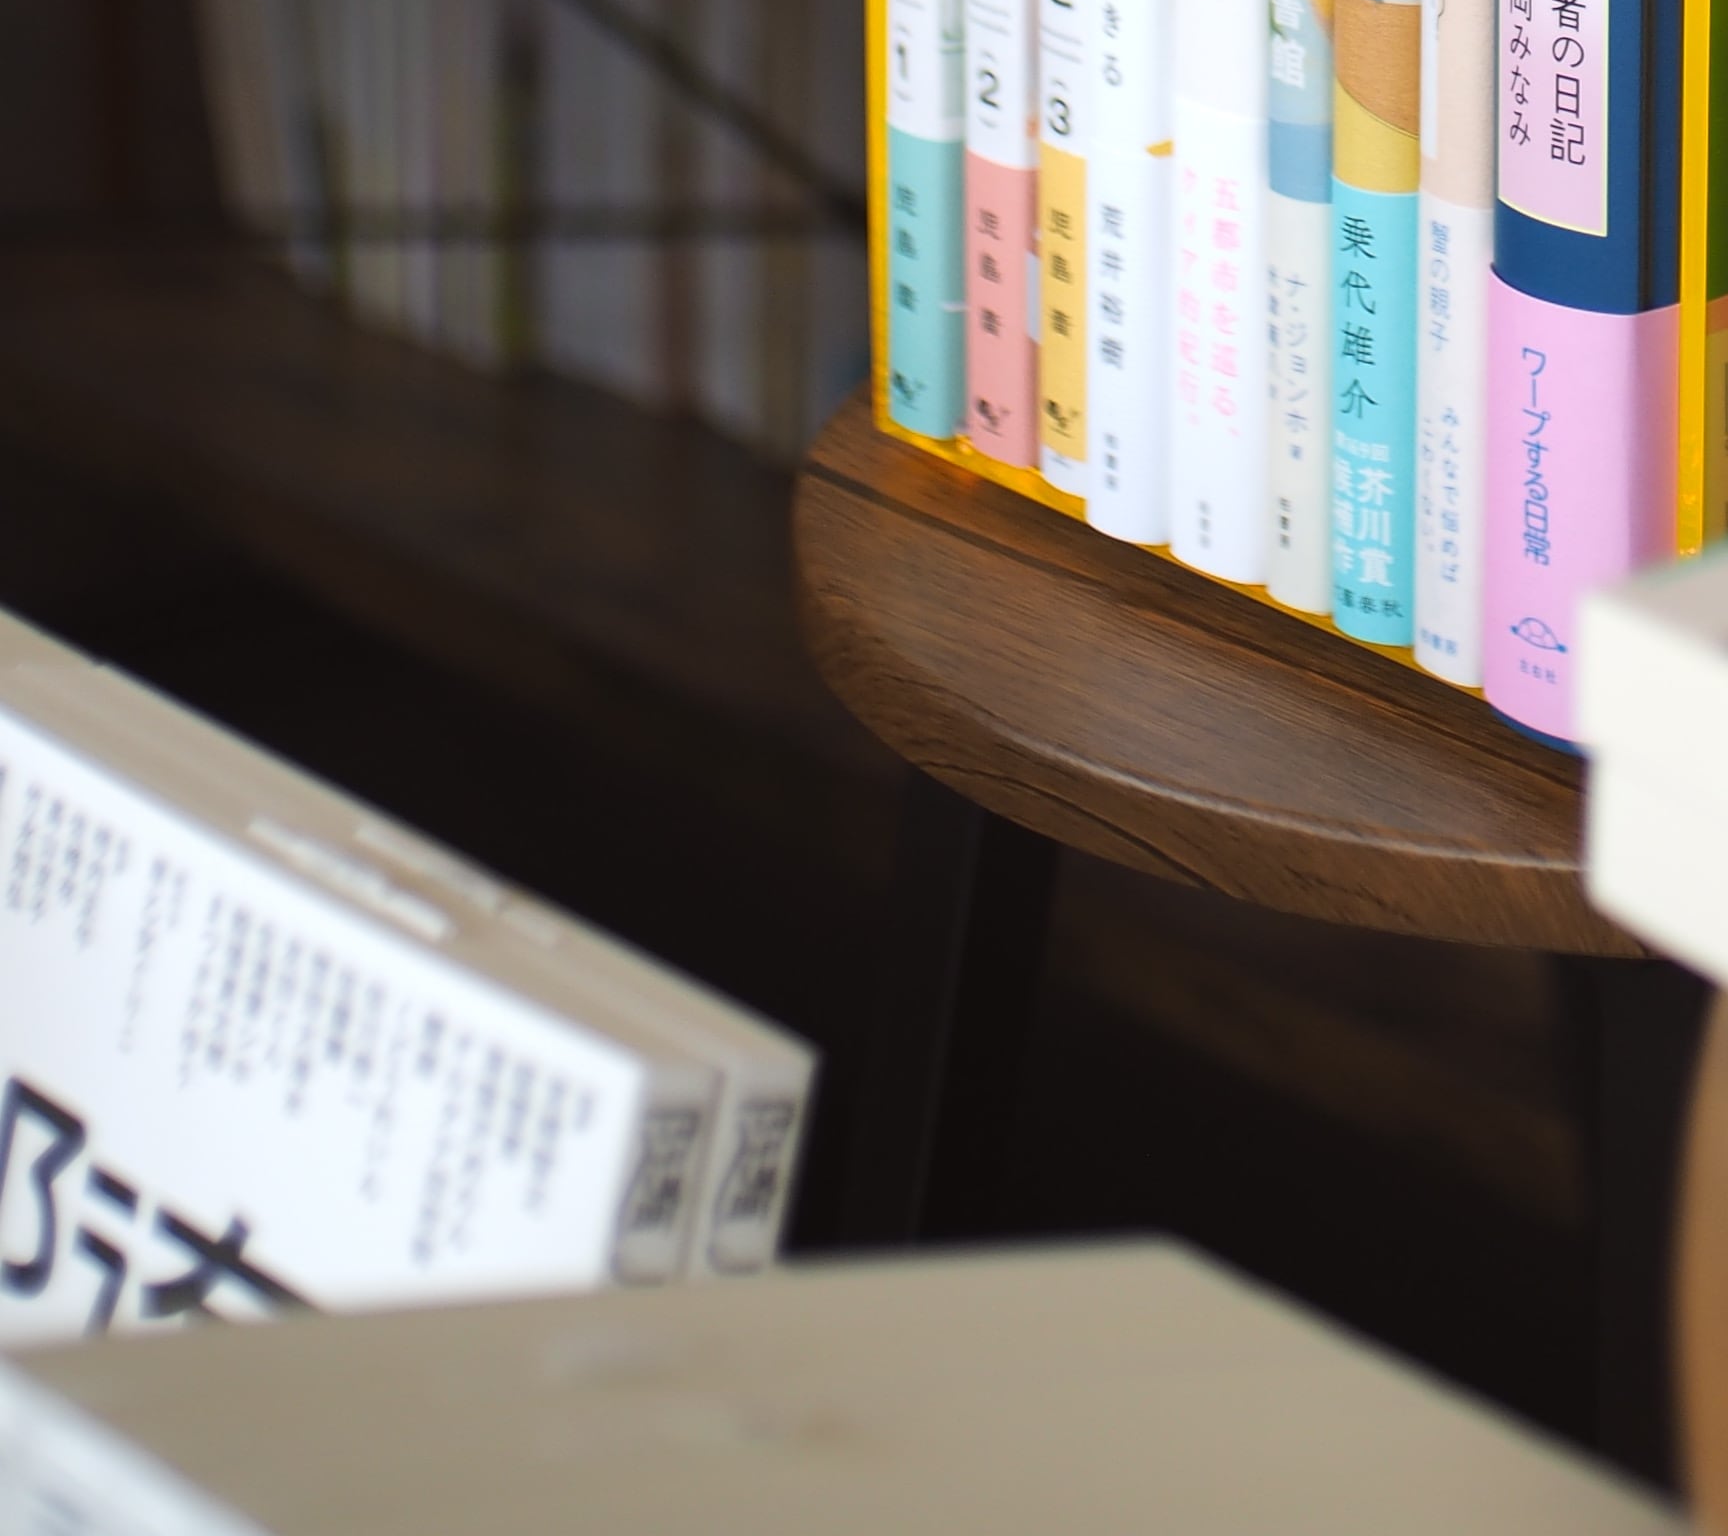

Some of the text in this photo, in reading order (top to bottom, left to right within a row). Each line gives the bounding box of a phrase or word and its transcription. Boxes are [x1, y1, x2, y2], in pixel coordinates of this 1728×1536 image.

[1339, 214, 1380, 422] 乗代雄介
[1357, 466, 1395, 588] 芥川賞
[1521, 346, 1553, 568] ワープする日常
